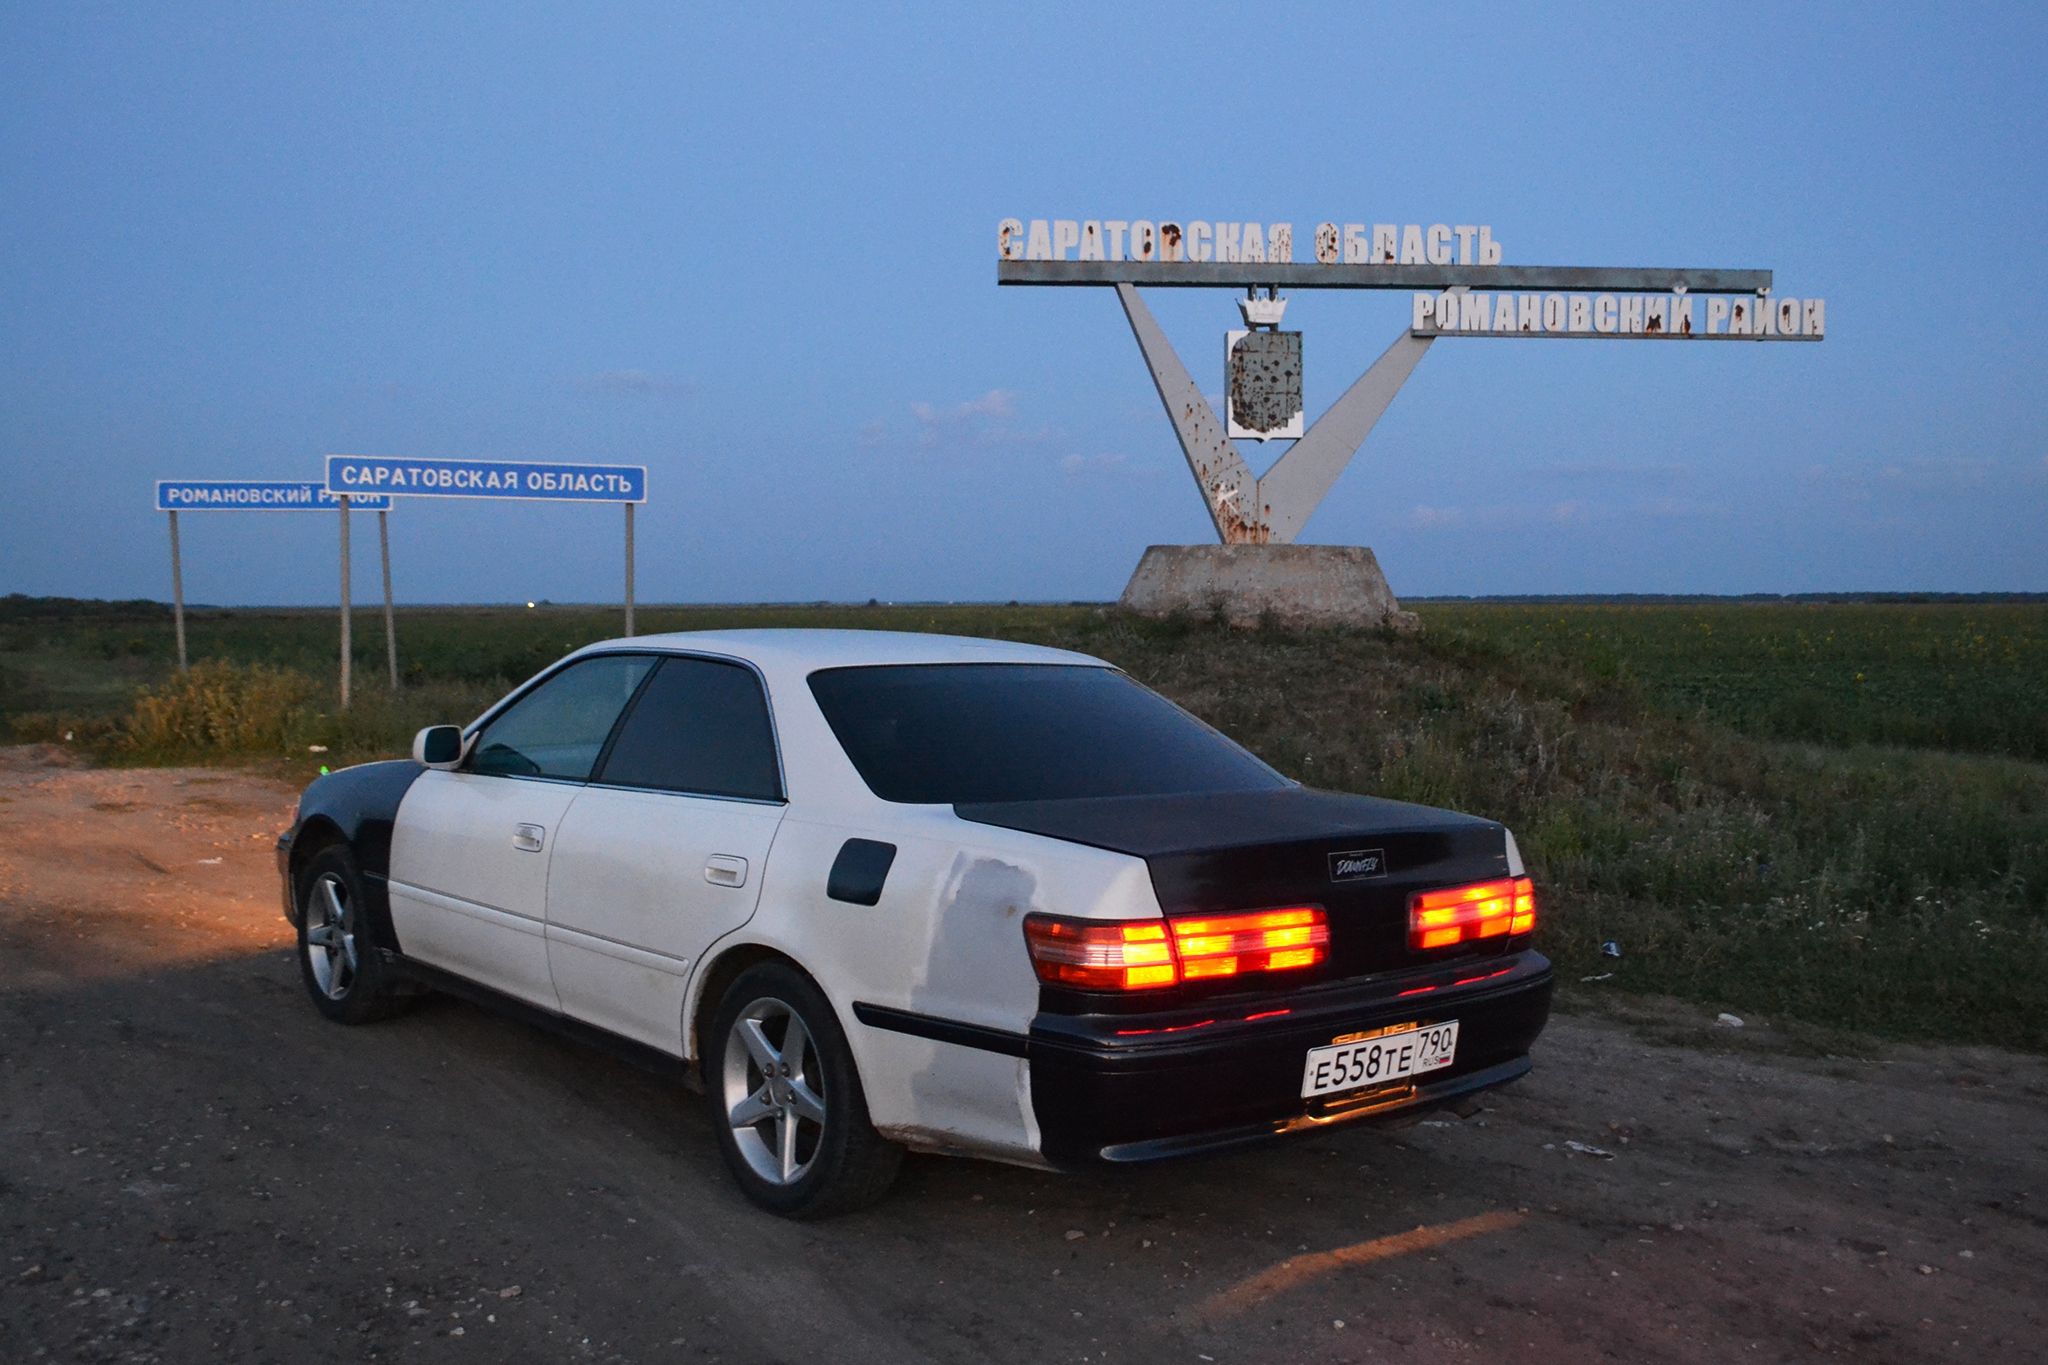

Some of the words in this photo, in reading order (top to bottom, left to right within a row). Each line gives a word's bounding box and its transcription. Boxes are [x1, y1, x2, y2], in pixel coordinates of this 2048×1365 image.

[998, 217, 1292, 263] САРАТОВСКАЯ
[1314, 222, 1502, 266] ОБЛАСТЬ
[1412, 282, 1693, 336] РОМАНОВСКИЙ
[1705, 287, 1825, 336] РАЙОН
[168, 485, 312, 503] РОМАНОВСКИЙ
[341, 465, 518, 489] САРАТОВСКАЯ
[527, 471, 632, 493] ОБЛАСТЬ
[1418, 1027, 1453, 1059] 790
[1422, 1055, 1440, 1068] RUS
